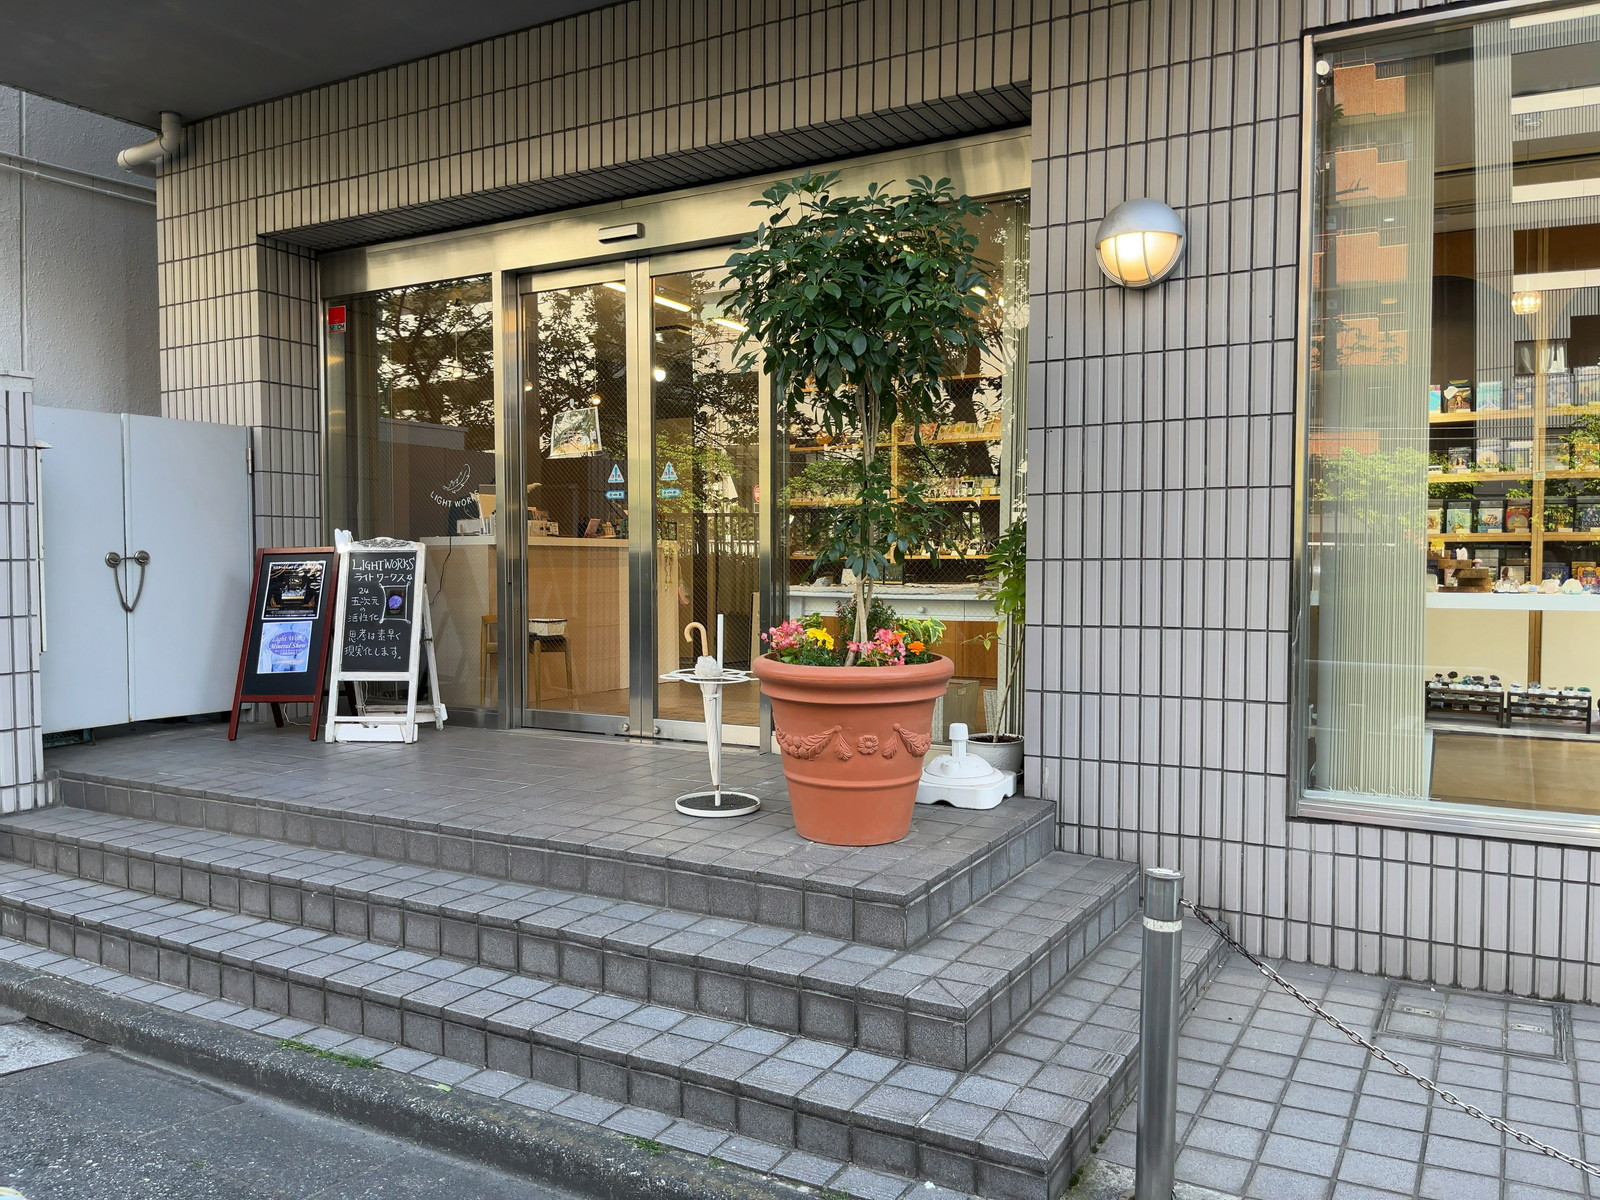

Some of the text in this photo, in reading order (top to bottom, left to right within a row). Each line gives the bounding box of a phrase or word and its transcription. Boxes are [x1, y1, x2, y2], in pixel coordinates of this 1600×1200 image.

[430, 490, 452, 508] LIGHT
[358, 587, 370, 595] 24
[351, 596, 379, 606] 五次元
[348, 612, 379, 623] 活性化
[347, 628, 402, 643] 思考は素早く
[270, 641, 308, 650] Mineral Show
[343, 643, 402, 660] 現実化します。
